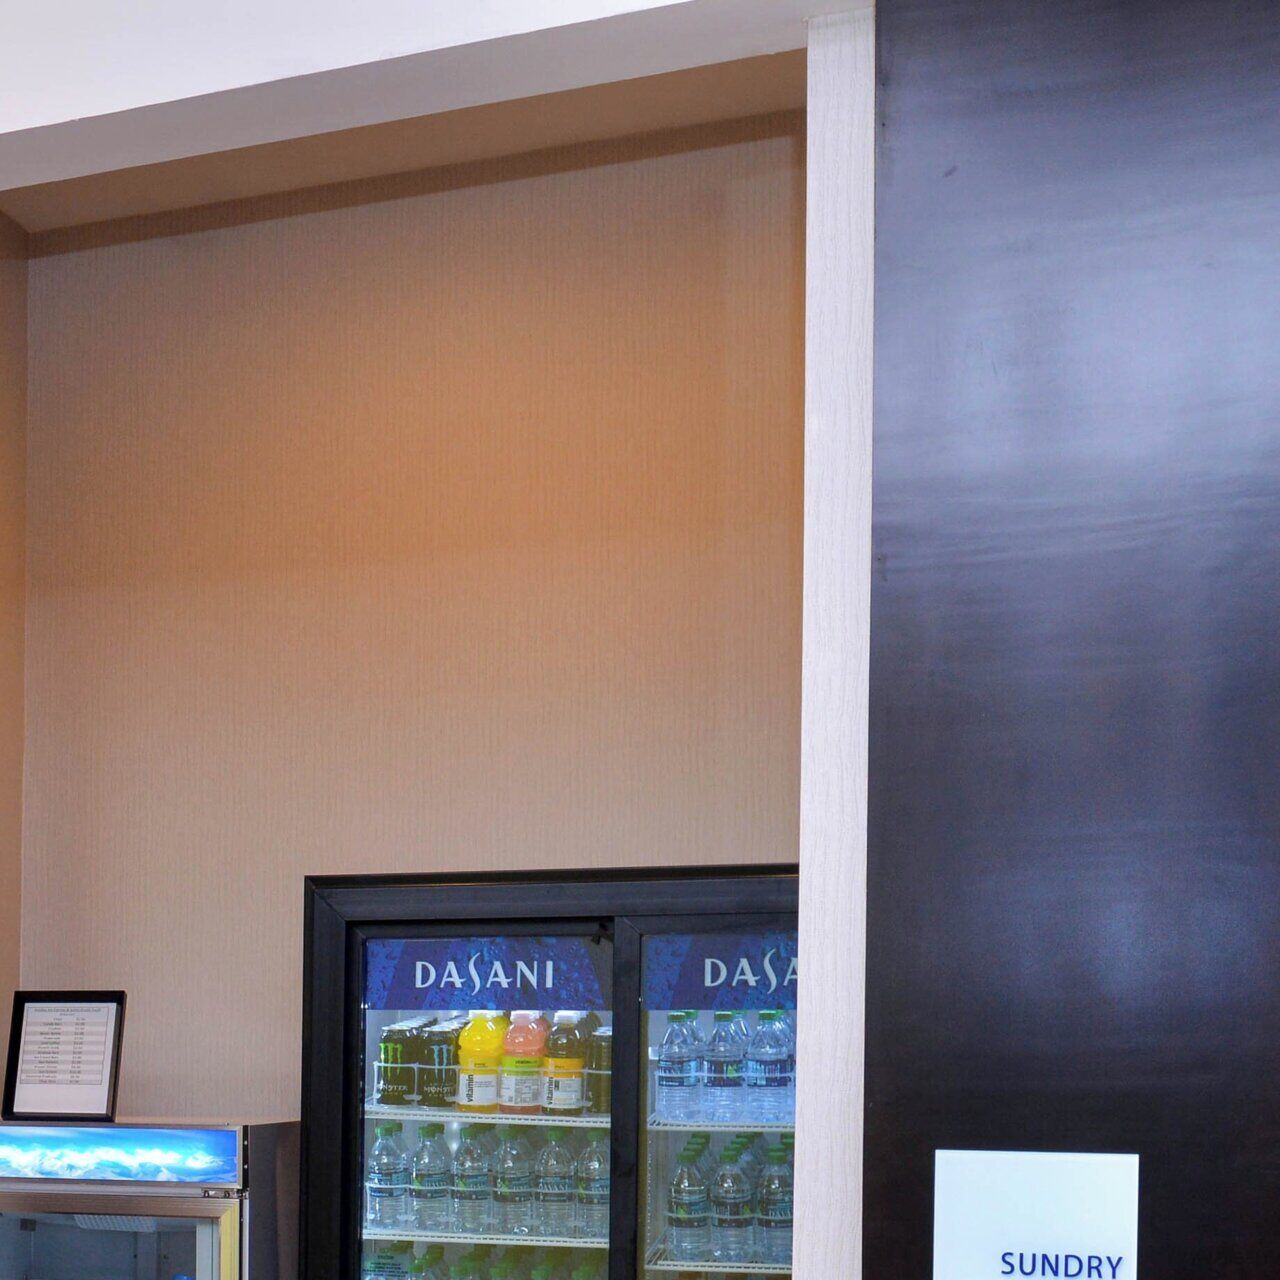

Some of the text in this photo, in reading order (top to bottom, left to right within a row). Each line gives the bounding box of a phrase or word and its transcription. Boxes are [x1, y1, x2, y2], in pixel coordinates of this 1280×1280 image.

[415, 952, 554, 996] DASANI
[704, 948, 798, 995] DASA
[424, 1084, 453, 1093] MONST
[466, 1074, 474, 1102] vitamin
[546, 1077, 554, 1105] vitamin
[1001, 1252, 1123, 1280] SUNDRY
